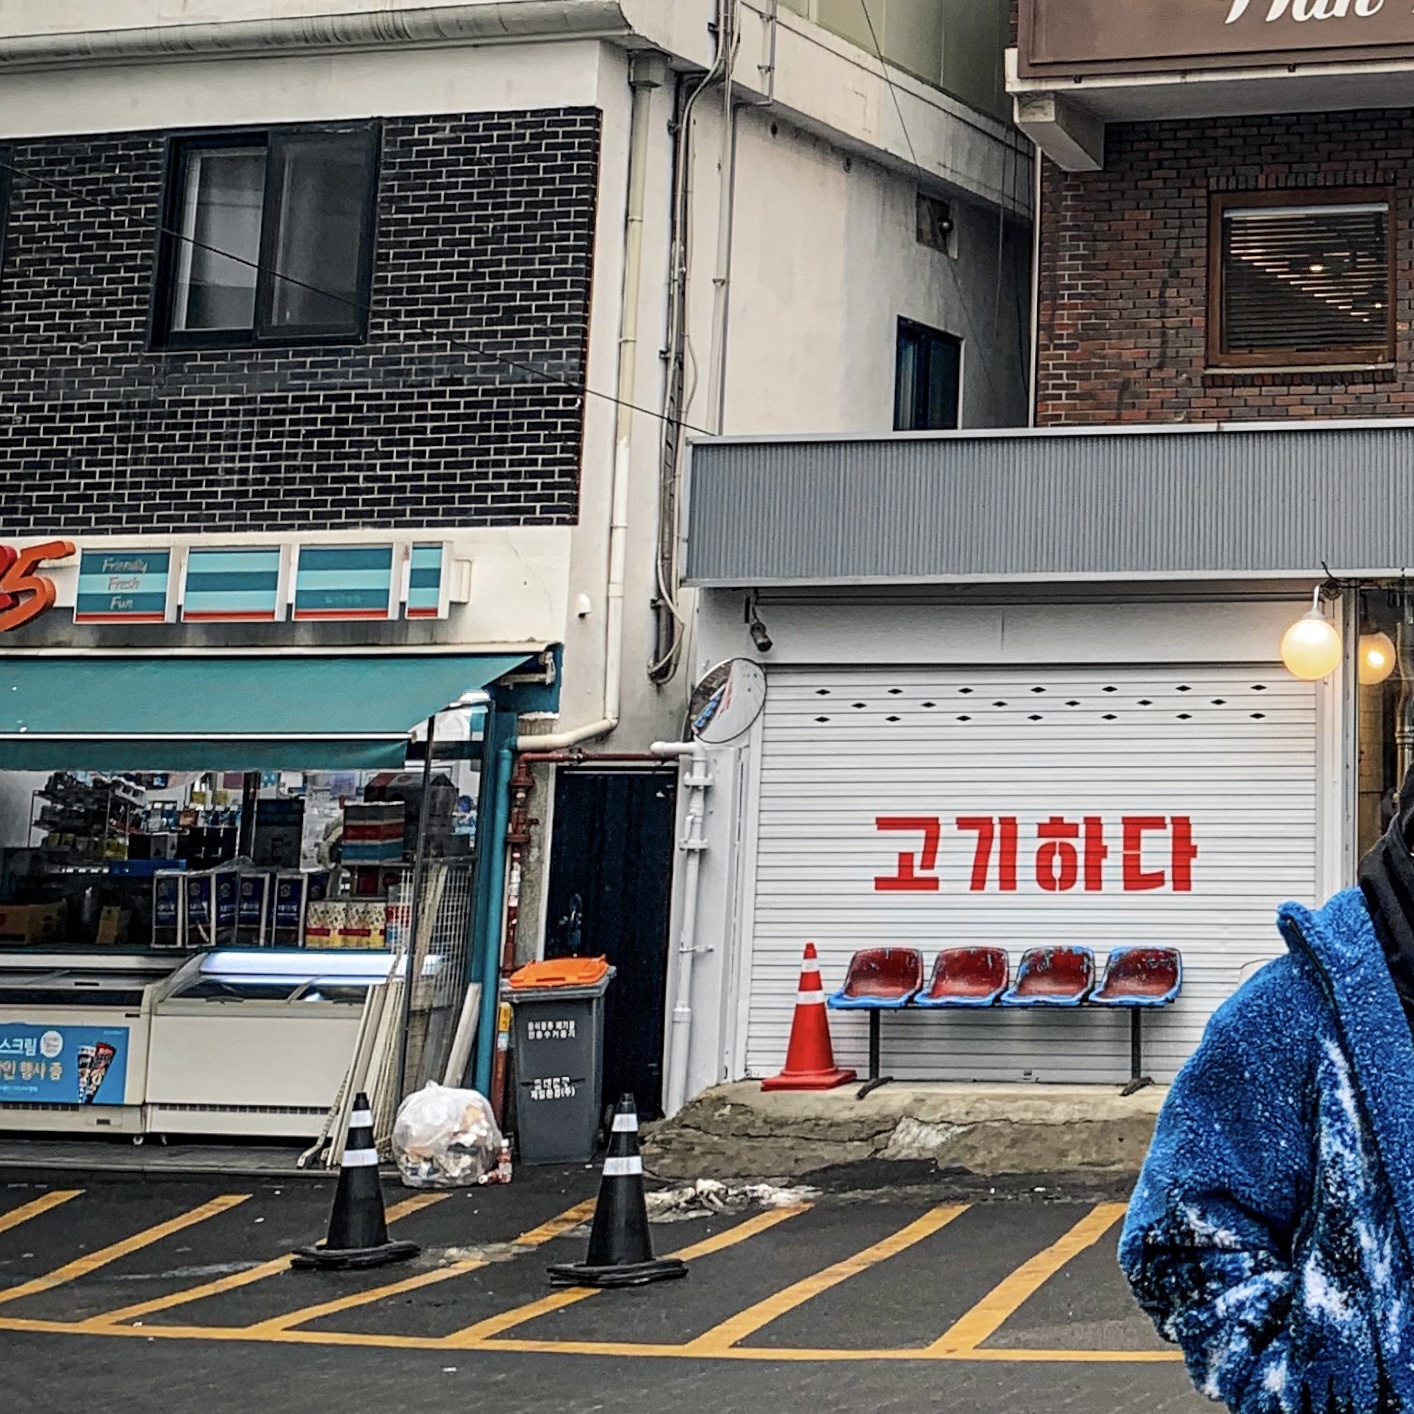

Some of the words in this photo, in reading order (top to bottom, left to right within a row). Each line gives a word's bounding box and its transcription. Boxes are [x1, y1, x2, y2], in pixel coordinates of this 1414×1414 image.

[102, 558, 148, 574] Friendly
[108, 576, 140, 591] Fresh
[110, 595, 134, 610] Fun
[873, 815, 1198, 892] 고기하다
